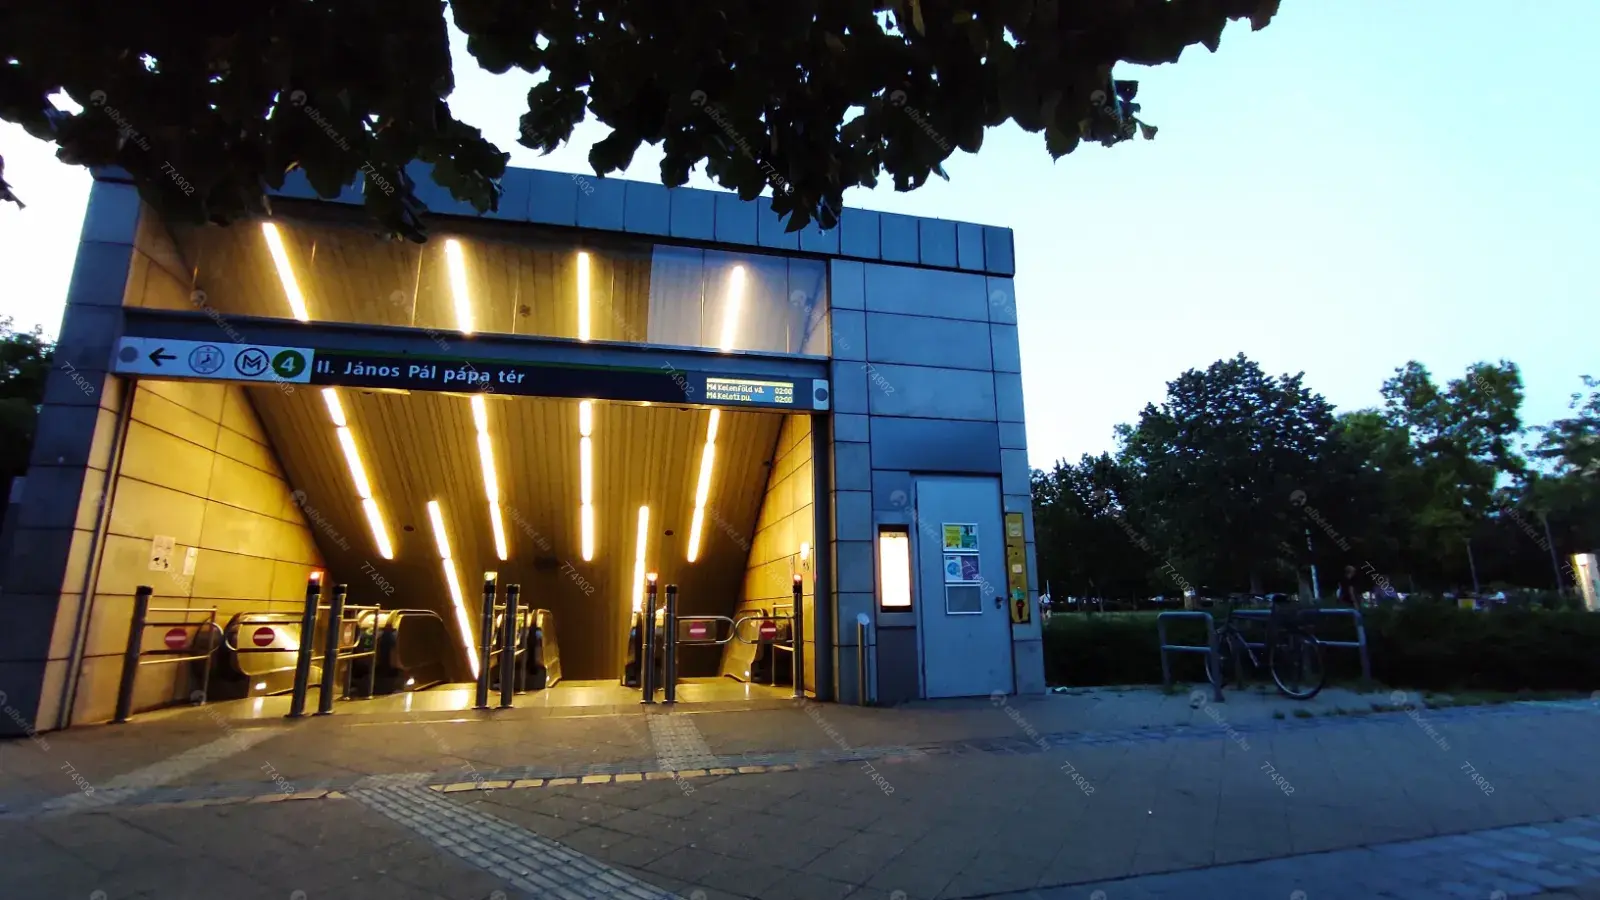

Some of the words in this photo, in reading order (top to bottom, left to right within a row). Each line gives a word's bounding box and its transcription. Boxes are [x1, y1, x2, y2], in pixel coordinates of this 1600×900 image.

[279, 356, 296, 373] 4
[316, 359, 335, 374] II.
[343, 361, 400, 377] János
[408, 364, 436, 379] Pál
[443, 366, 490, 385] pápa
[498, 370, 525, 384] tér
[718, 384, 753, 393] Kelenföld
[718, 392, 740, 400] Keleti
